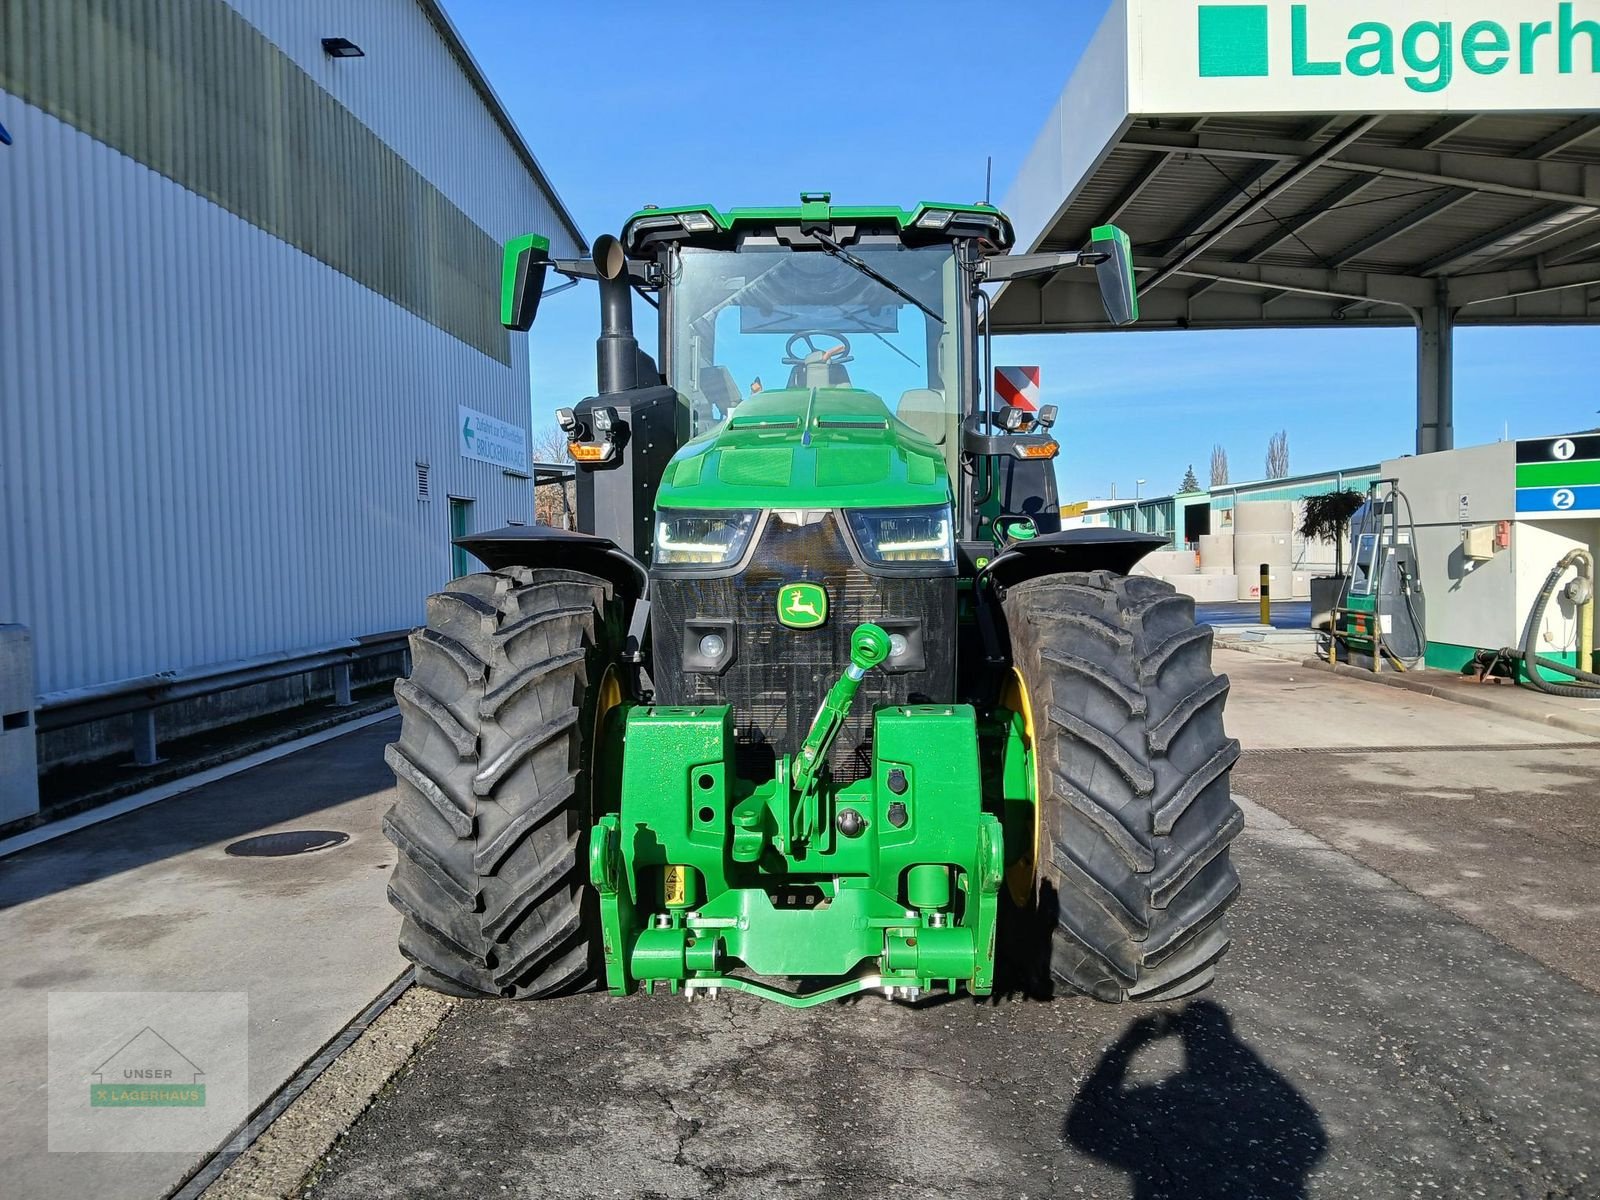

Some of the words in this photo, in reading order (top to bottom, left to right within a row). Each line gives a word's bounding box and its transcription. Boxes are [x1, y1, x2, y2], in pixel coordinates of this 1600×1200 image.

[1291, 2, 1600, 93] Lagerh
[1558, 442, 1568, 456] 1
[1557, 492, 1570, 506] 2
